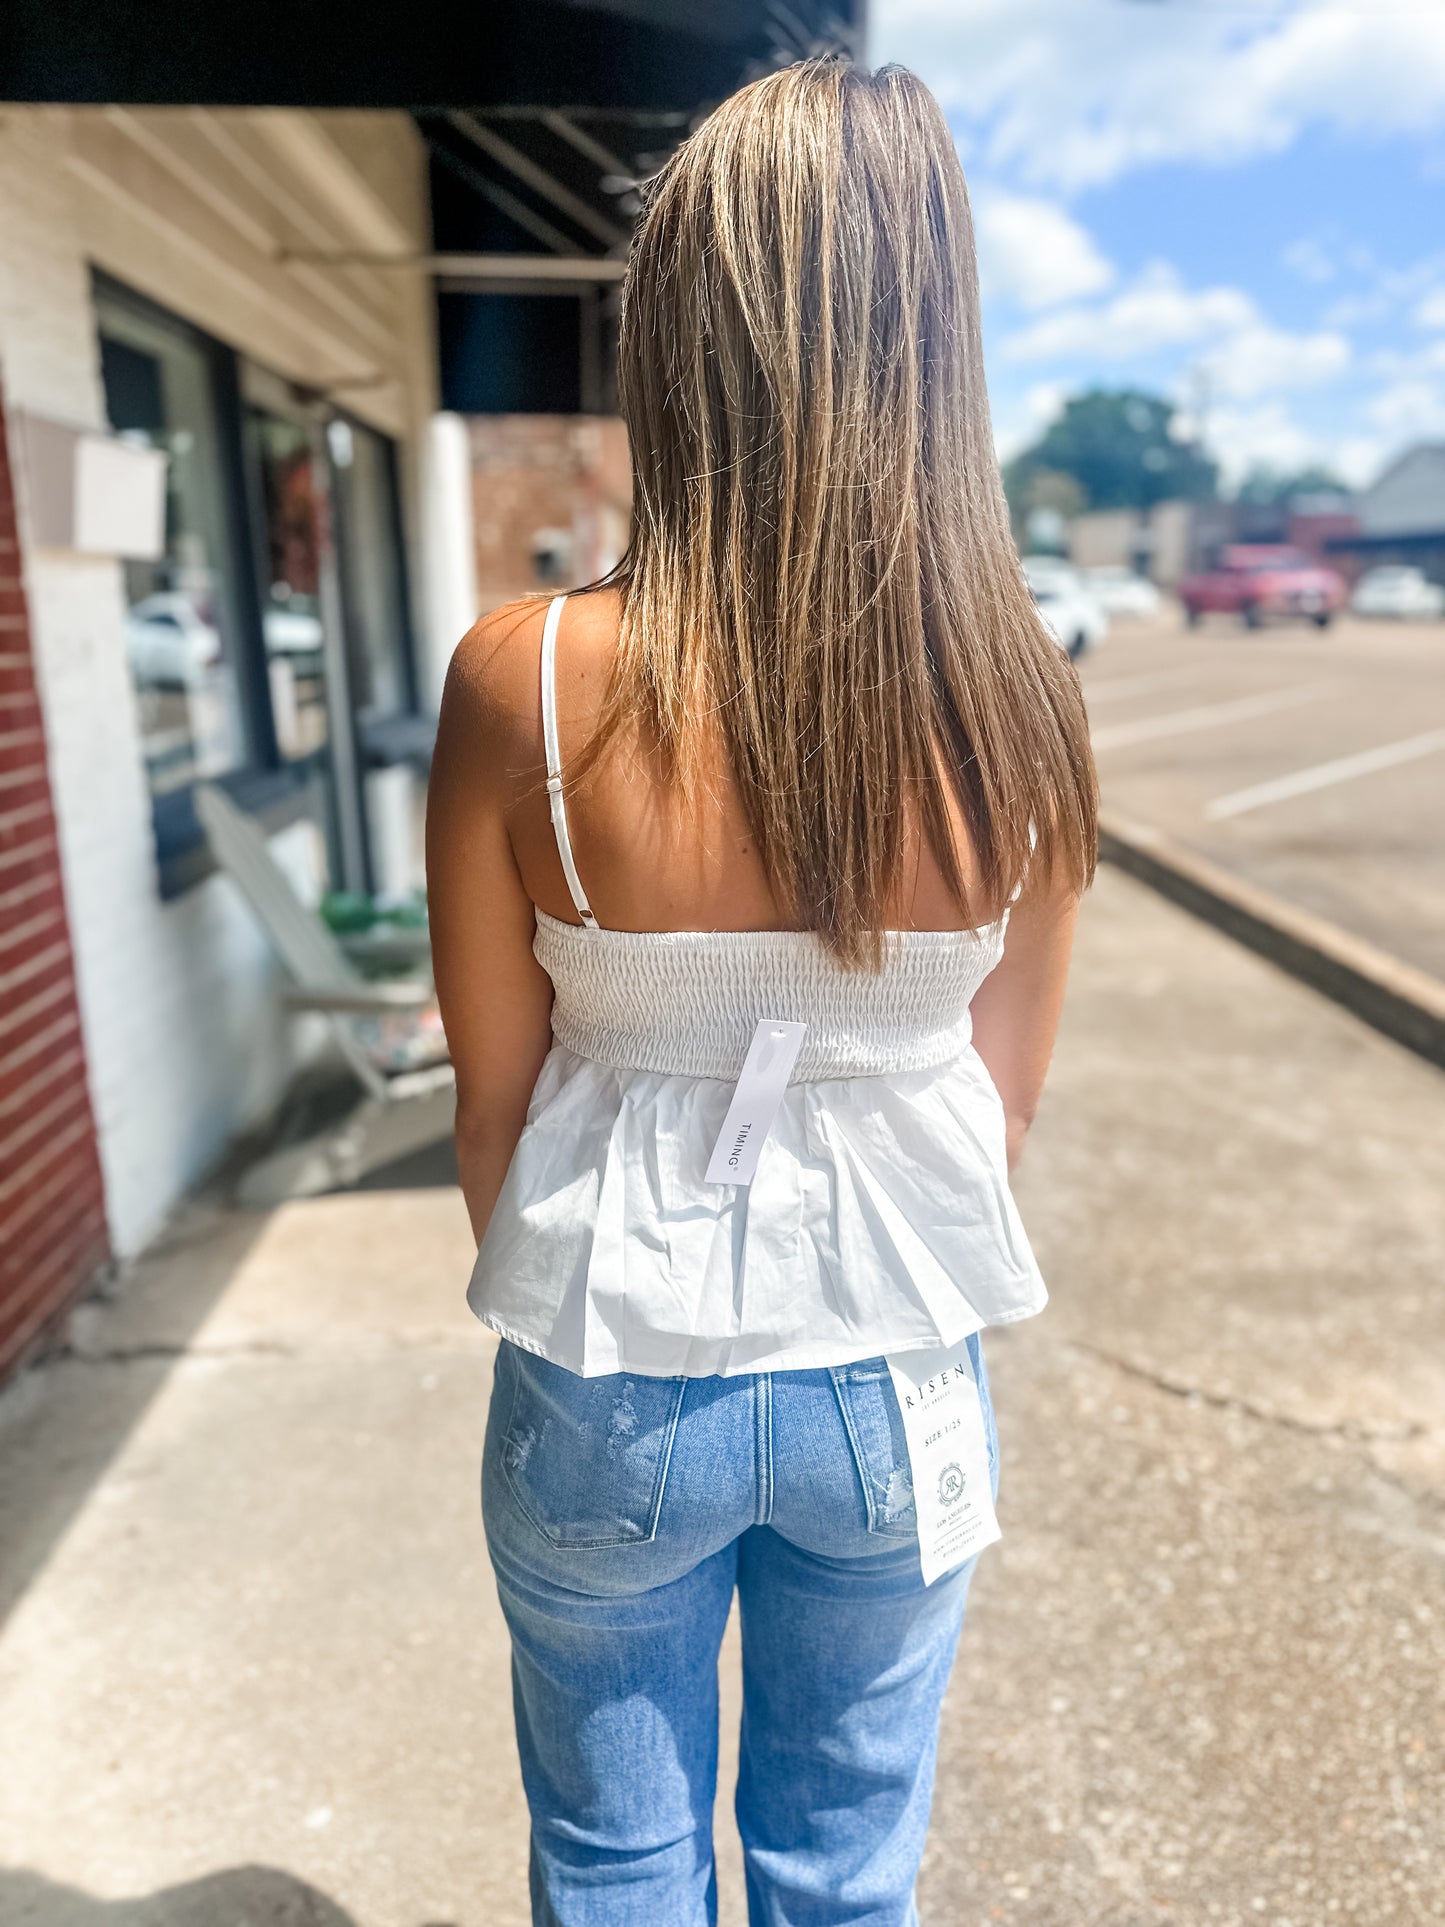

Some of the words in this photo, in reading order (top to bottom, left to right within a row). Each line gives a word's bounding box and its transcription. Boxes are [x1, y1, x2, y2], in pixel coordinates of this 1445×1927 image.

[728, 1123, 752, 1166] TIMING
[905, 1363, 965, 1409] RISEN
[924, 1430, 942, 1448] SIZE
